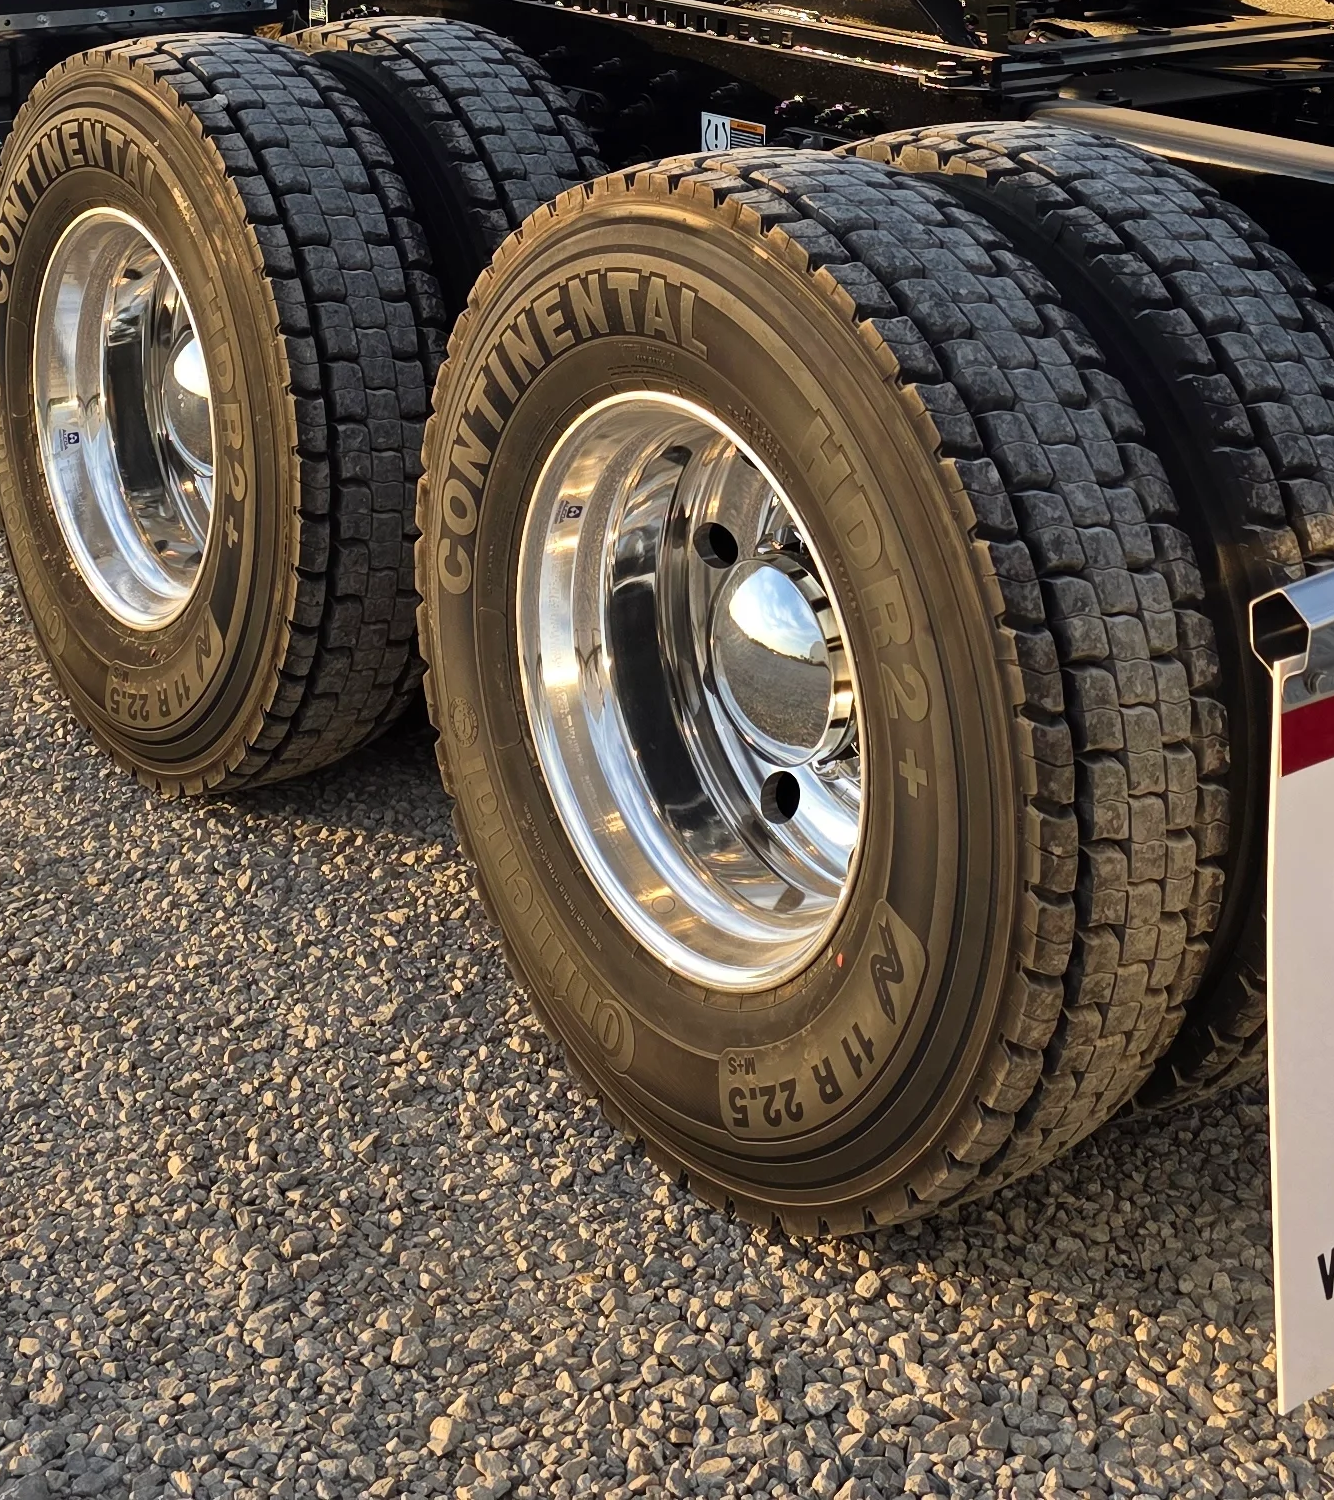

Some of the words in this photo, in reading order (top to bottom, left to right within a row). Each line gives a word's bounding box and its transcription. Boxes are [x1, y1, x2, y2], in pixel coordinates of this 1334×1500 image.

[437, 269, 708, 594] CONTINENTAL
[110, 687, 150, 722] 22.5
[157, 682, 171, 718] R
[174, 672, 191, 709] 11
[728, 1056, 757, 1076] M+S
[841, 1021, 875, 1080] 11
[811, 1056, 844, 1105] R
[728, 1077, 804, 1128] 22.5
